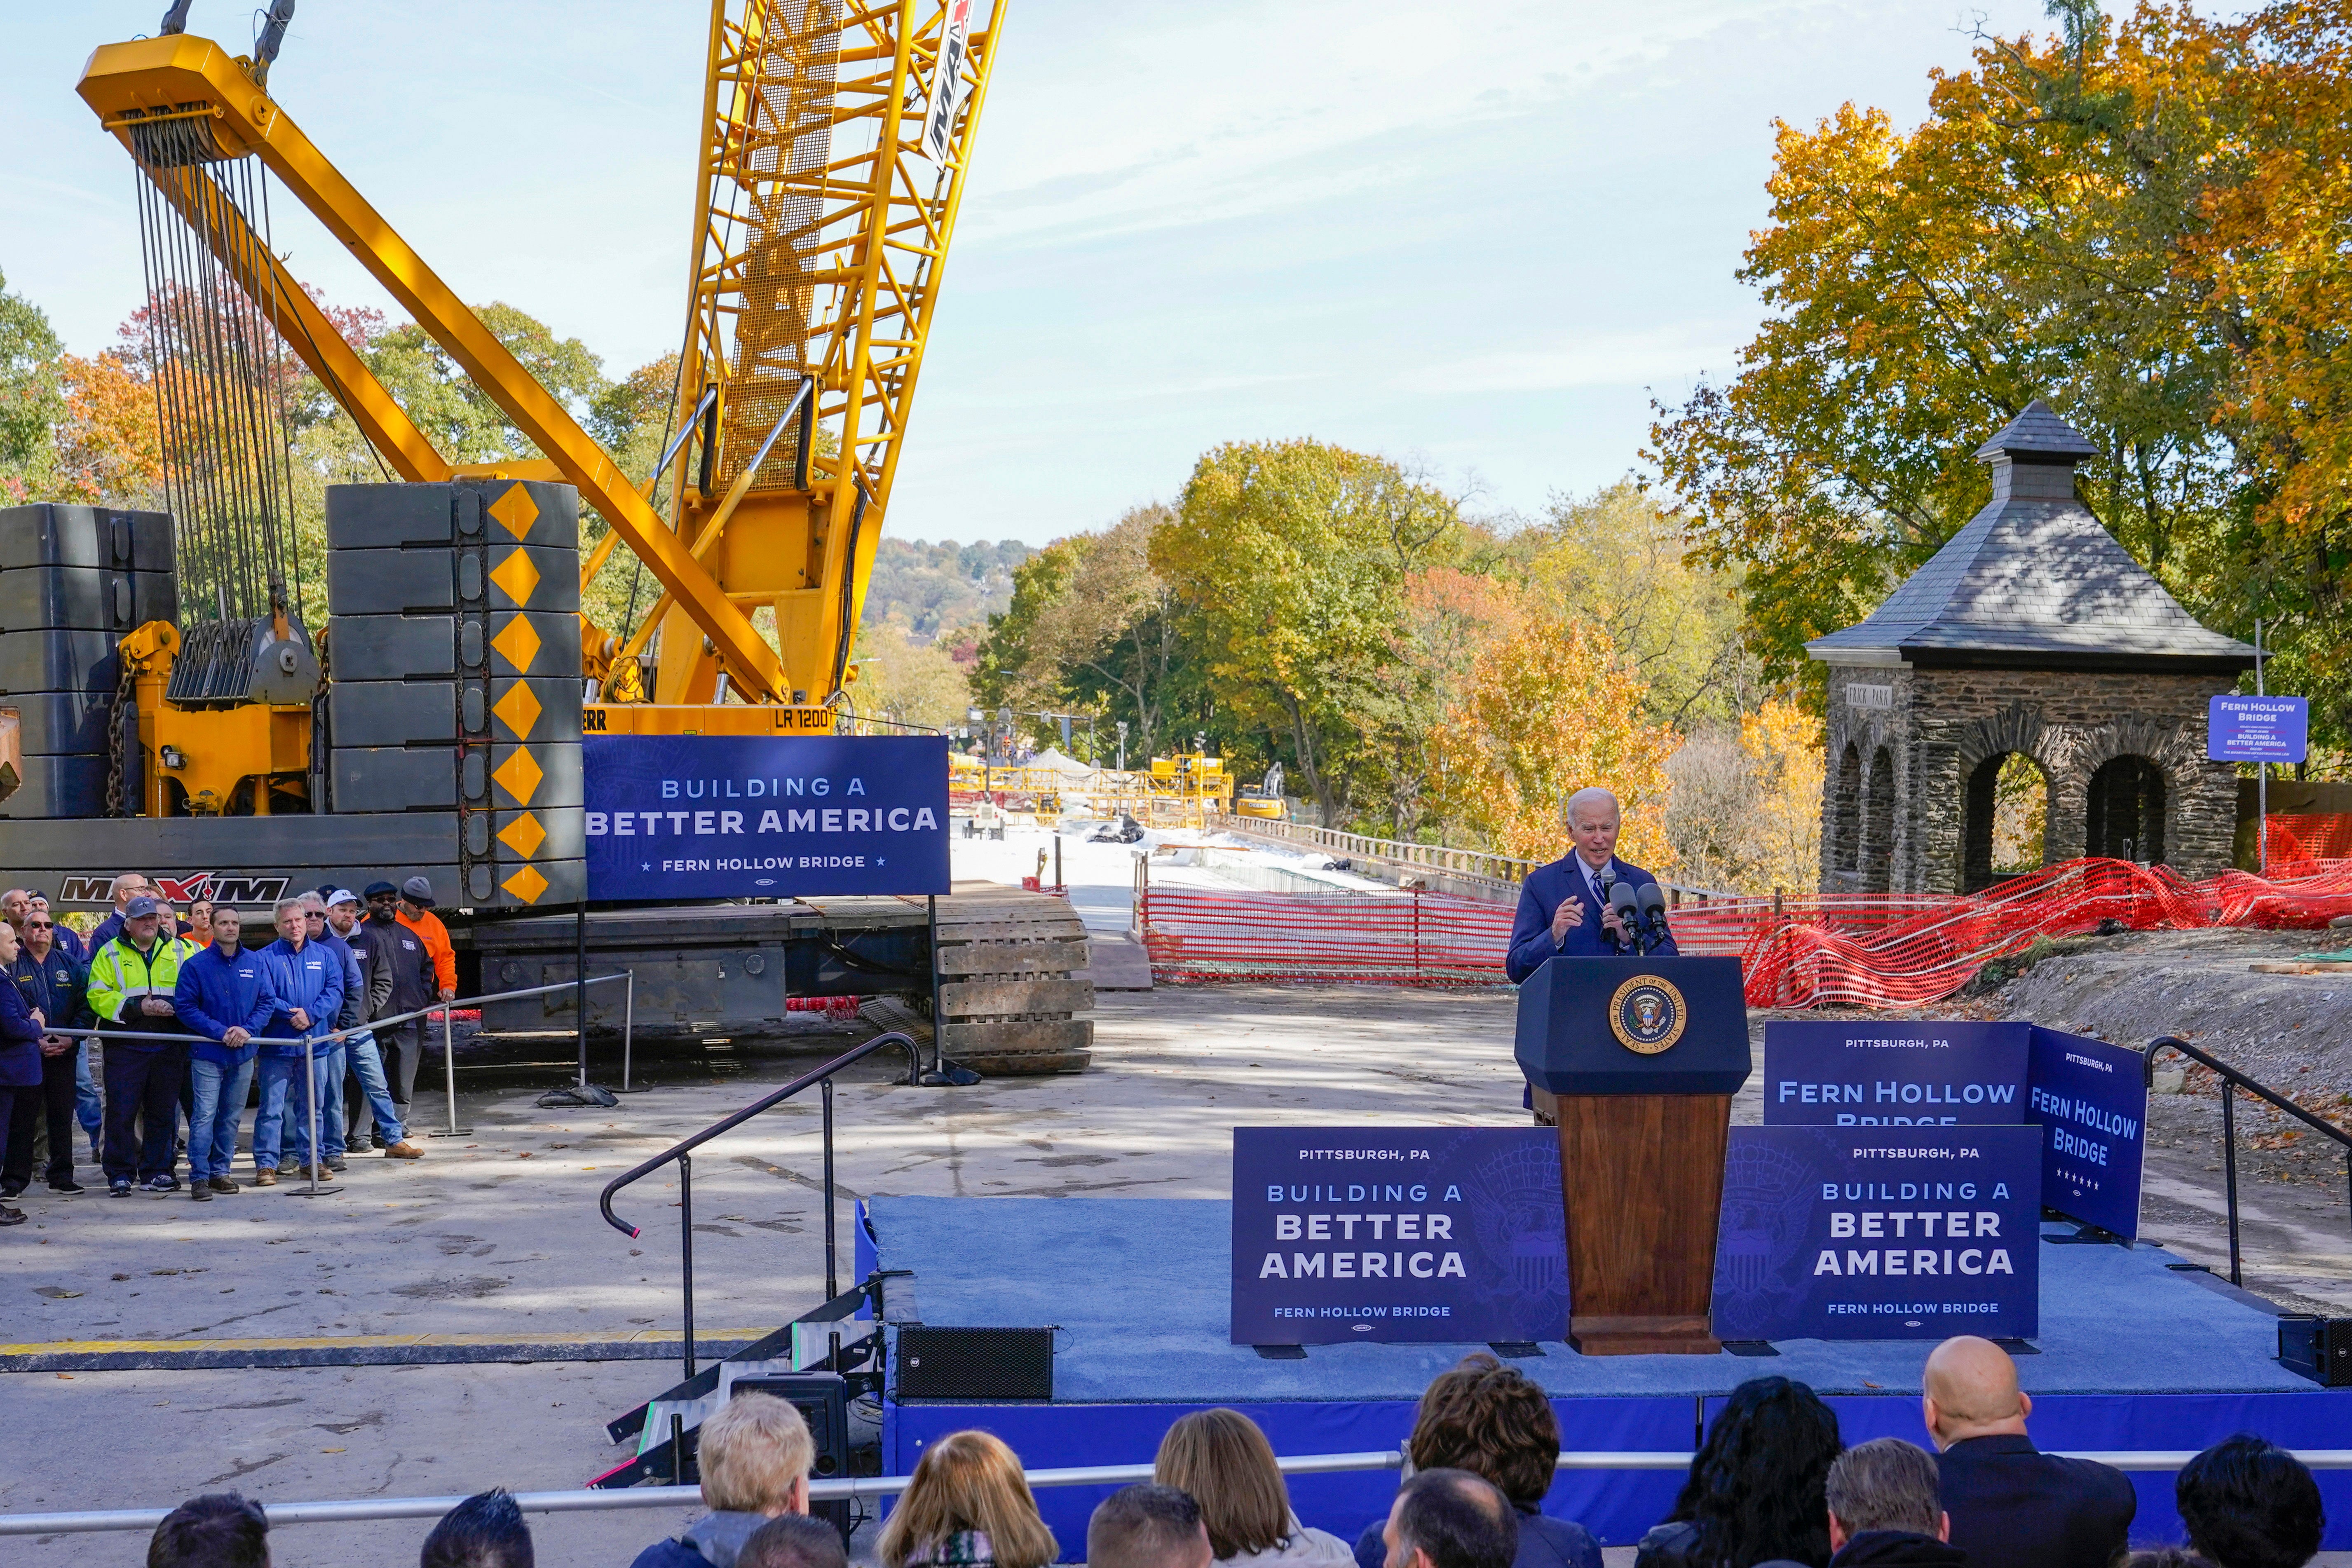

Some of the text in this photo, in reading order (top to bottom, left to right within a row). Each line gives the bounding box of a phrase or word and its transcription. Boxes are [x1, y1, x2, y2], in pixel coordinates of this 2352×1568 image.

[1849, 687, 1888, 706] FRICK PARK
[2221, 702, 2295, 712] FERN HOLLOW
[776, 710, 828, 728] LR 1200
[2239, 713, 2277, 722] BRIDGE
[663, 778, 865, 798] BUILDING A
[585, 808, 938, 835] BETTER AMERICA
[663, 856, 864, 871] FERN HOLLOW BRIDGE
[58, 871, 291, 903] MXIM
[1613, 978, 1647, 1011] PRESIDENT
[1668, 988, 1684, 1020] UNITED
[1622, 1031, 1640, 1049] SEAL
[1654, 1027, 1680, 1050] STATES
[1846, 1040, 1928, 1049] PITTSBURGH,
[2066, 1053, 2113, 1073] PITTSBURGH, PA
[1780, 1082, 2015, 1103] FERN HOLLOW
[2031, 1087, 2137, 1140] FERN HOLLOW
[1300, 1150, 1430, 1161] PITTSBURGH, PA
[1854, 1148, 1979, 1160] PITTSBURGH, PA
[2054, 1127, 2107, 1166] BRIDGE
[1268, 1185, 1461, 1202] BUILDING A
[1823, 1183, 2009, 1200] BUILDING A
[1277, 1214, 1452, 1240] BETTER
[1831, 1212, 2000, 1237] BETTER
[1259, 1252, 1466, 1278] AMERICA
[1814, 1249, 2013, 1275] AMERICA
[1275, 1307, 1449, 1317] FERN HOLLOW BRIDGE
[1829, 1303, 1998, 1313] FERN HOLLOW BRIDGE
